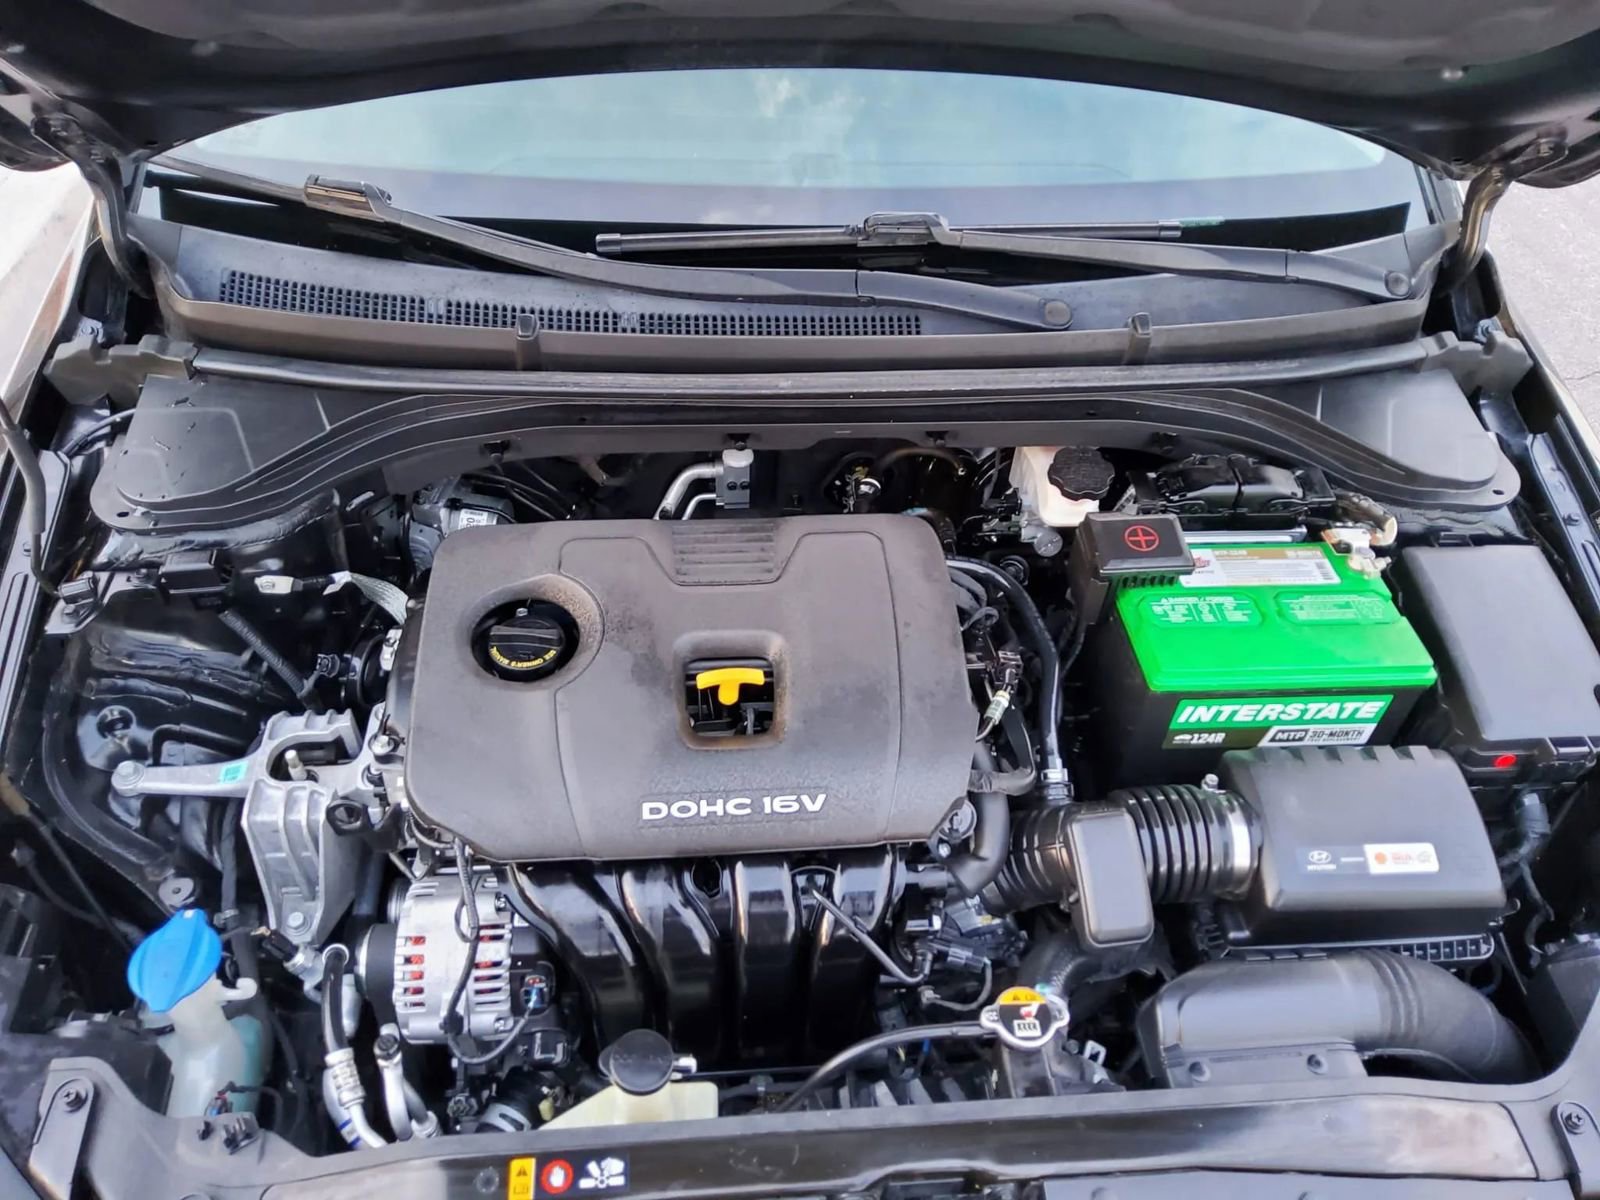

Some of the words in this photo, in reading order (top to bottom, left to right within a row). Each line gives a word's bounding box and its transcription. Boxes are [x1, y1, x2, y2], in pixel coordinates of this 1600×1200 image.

[1176, 701, 1386, 724] INTERSTATE
[1274, 731, 1305, 741] MTP
[641, 797, 752, 821] DOHC
[762, 793, 827, 815] 16V
